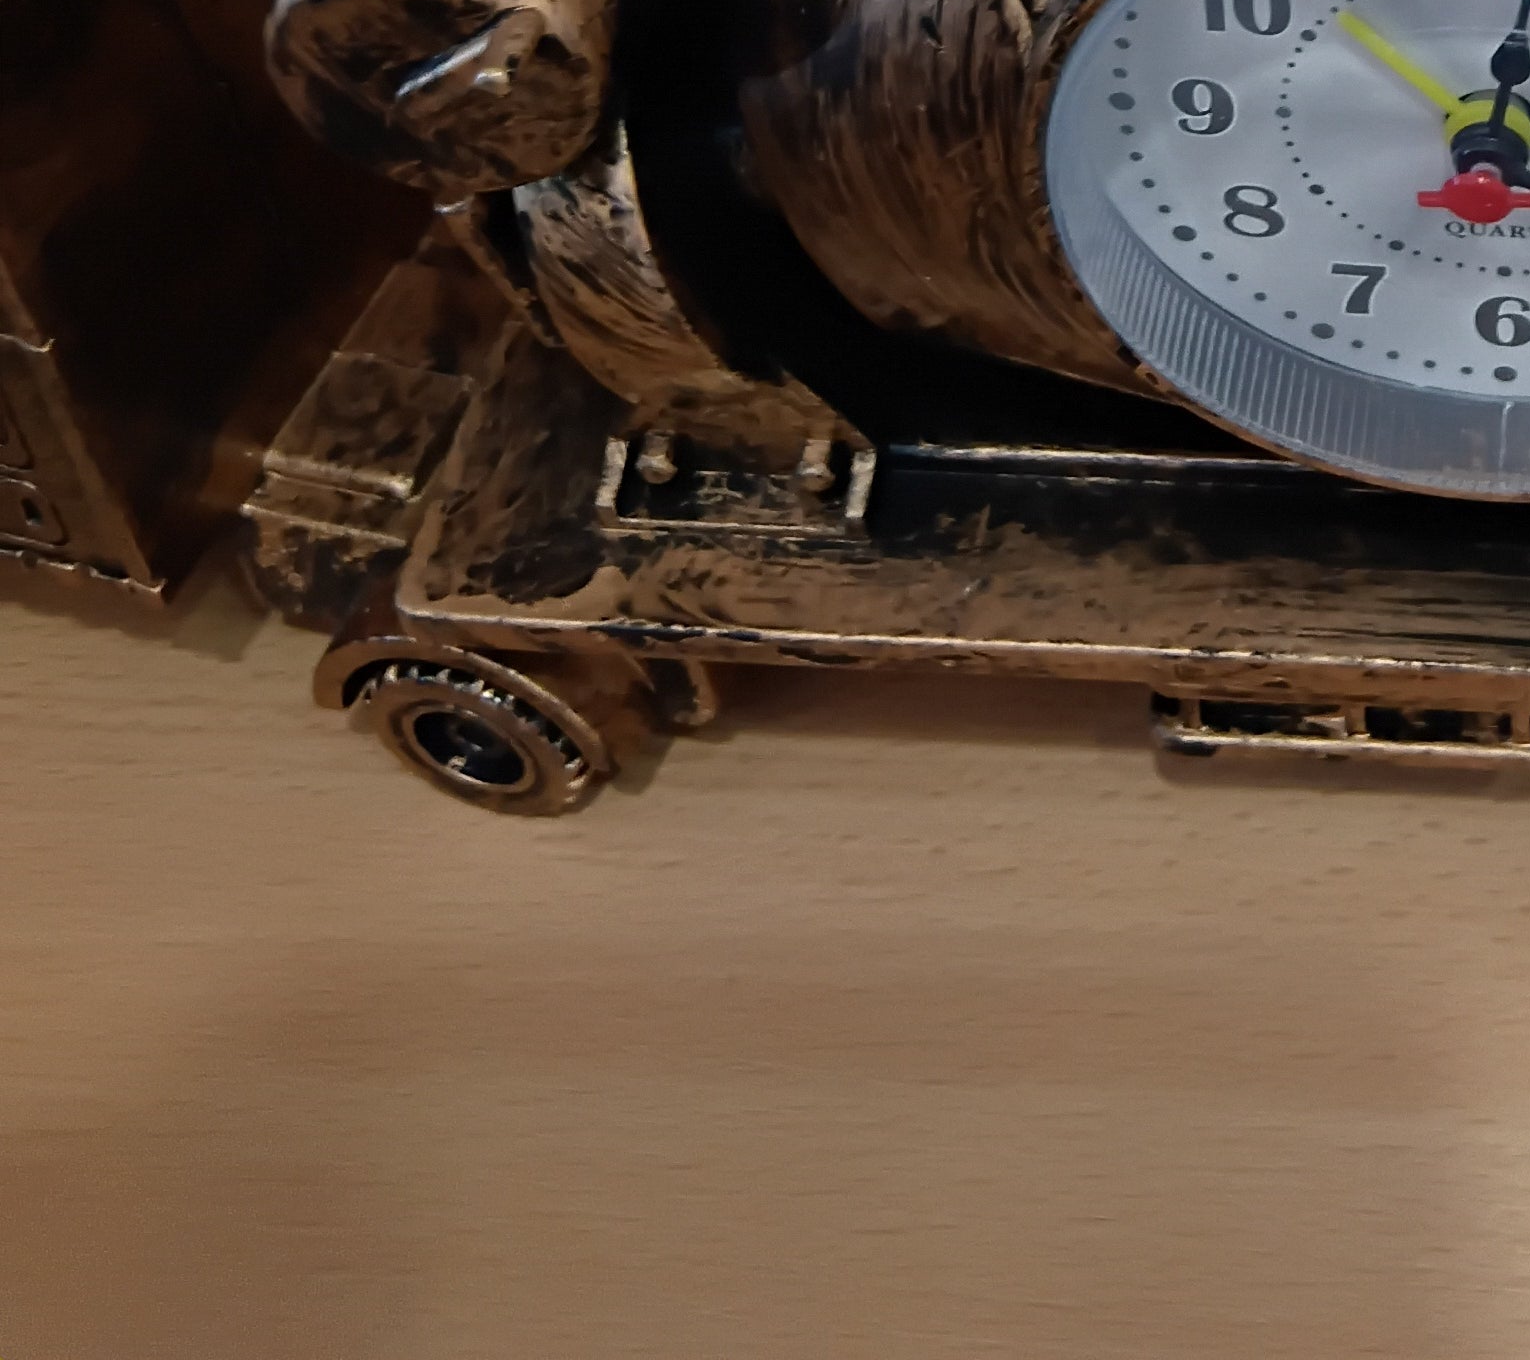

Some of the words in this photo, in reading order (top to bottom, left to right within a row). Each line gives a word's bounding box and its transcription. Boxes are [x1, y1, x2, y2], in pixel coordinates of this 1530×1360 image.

[1172, 78, 1235, 136] 9
[1224, 185, 1285, 238] 8
[1331, 263, 1387, 314] 7
